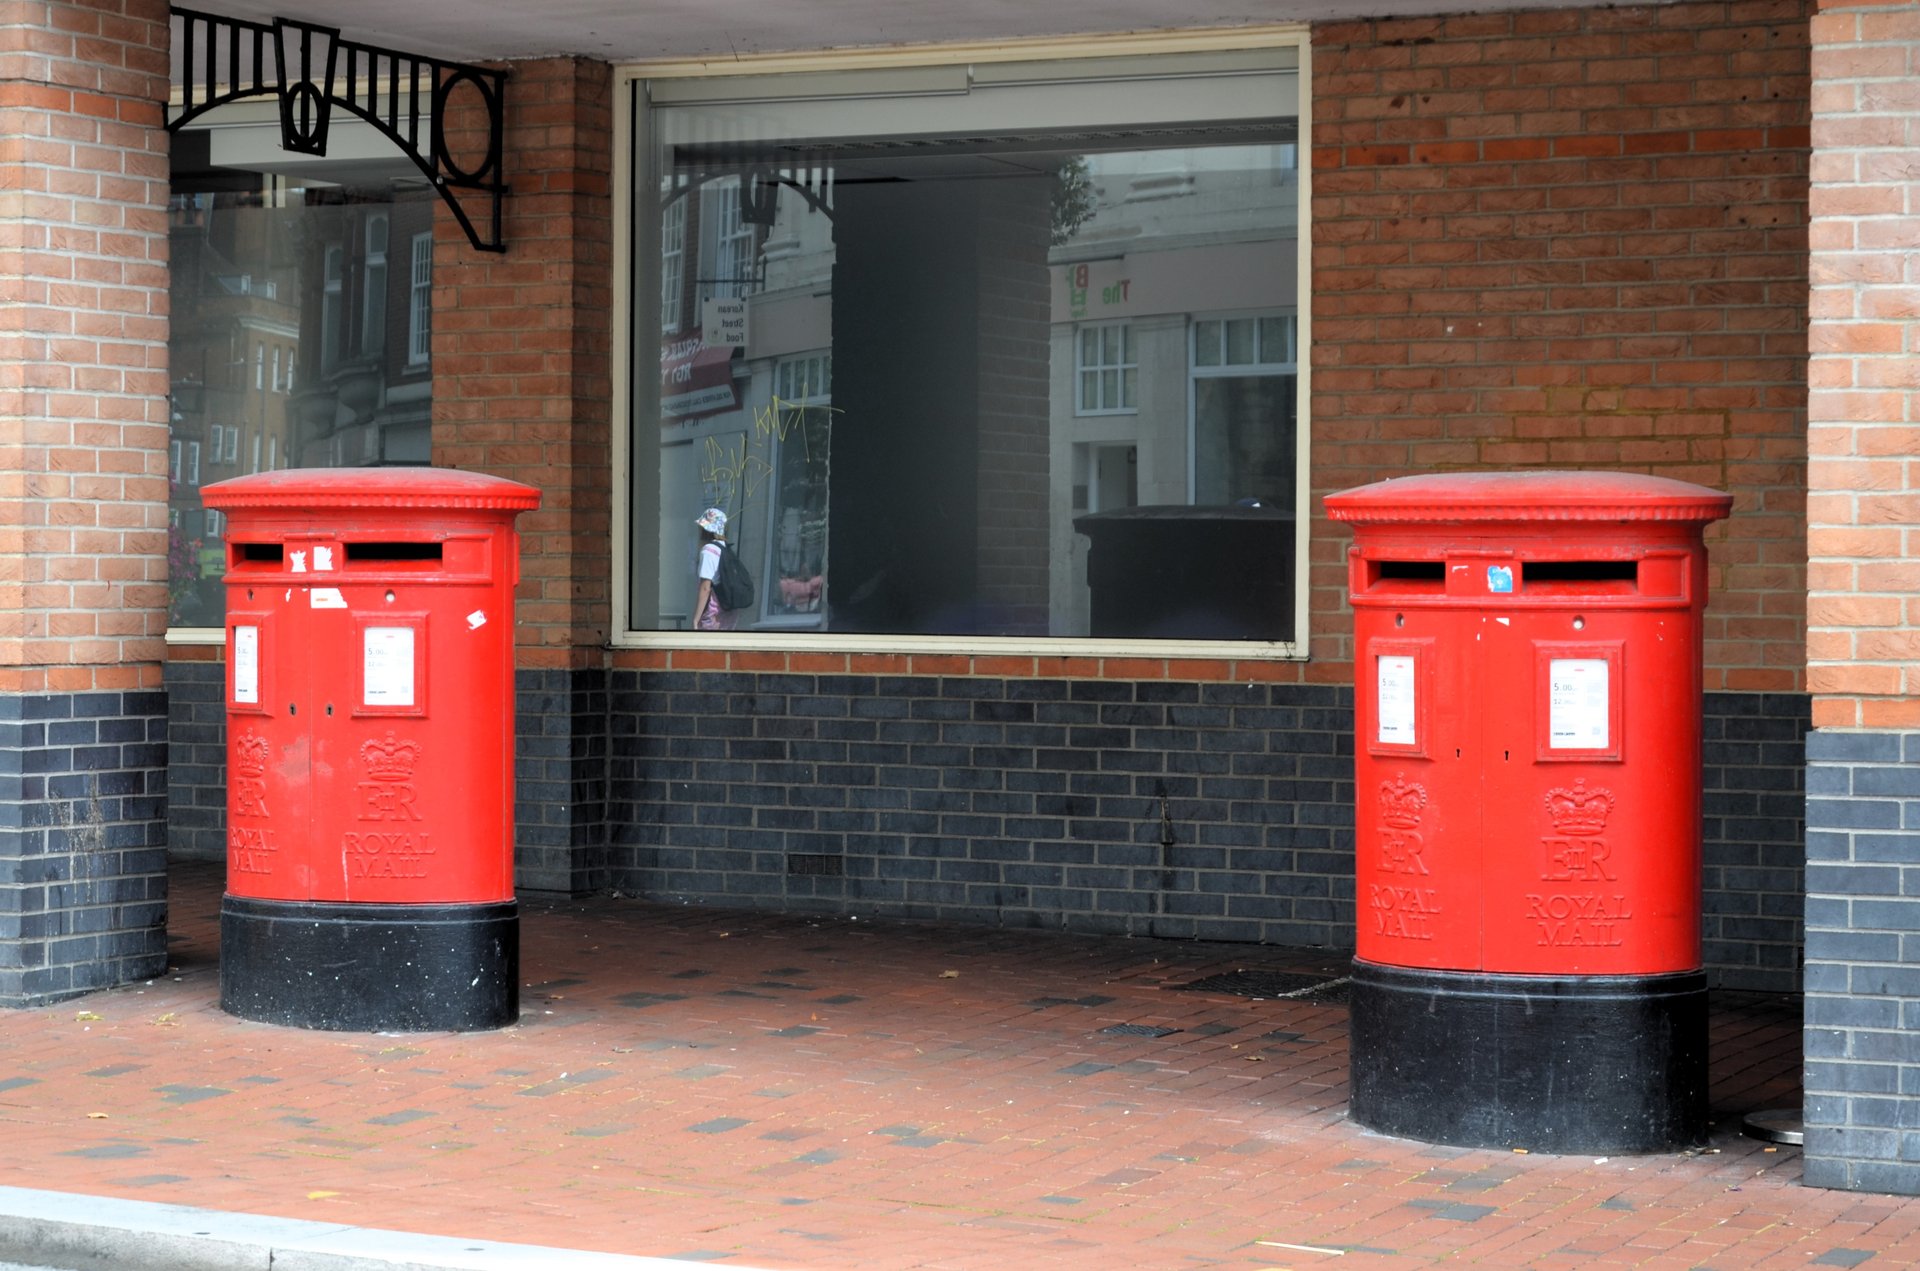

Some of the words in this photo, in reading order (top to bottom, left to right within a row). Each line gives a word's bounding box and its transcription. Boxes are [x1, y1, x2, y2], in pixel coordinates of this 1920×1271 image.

[230, 826, 278, 852] ROYAL
[344, 831, 436, 855] ROYAL
[233, 849, 272, 875] MAIL
[354, 855, 427, 878] MAIL
[1369, 883, 1441, 914] ROYAL
[1525, 893, 1633, 920] ROYAL
[1376, 911, 1433, 941] MAIL
[1537, 921, 1623, 947] MAIL
